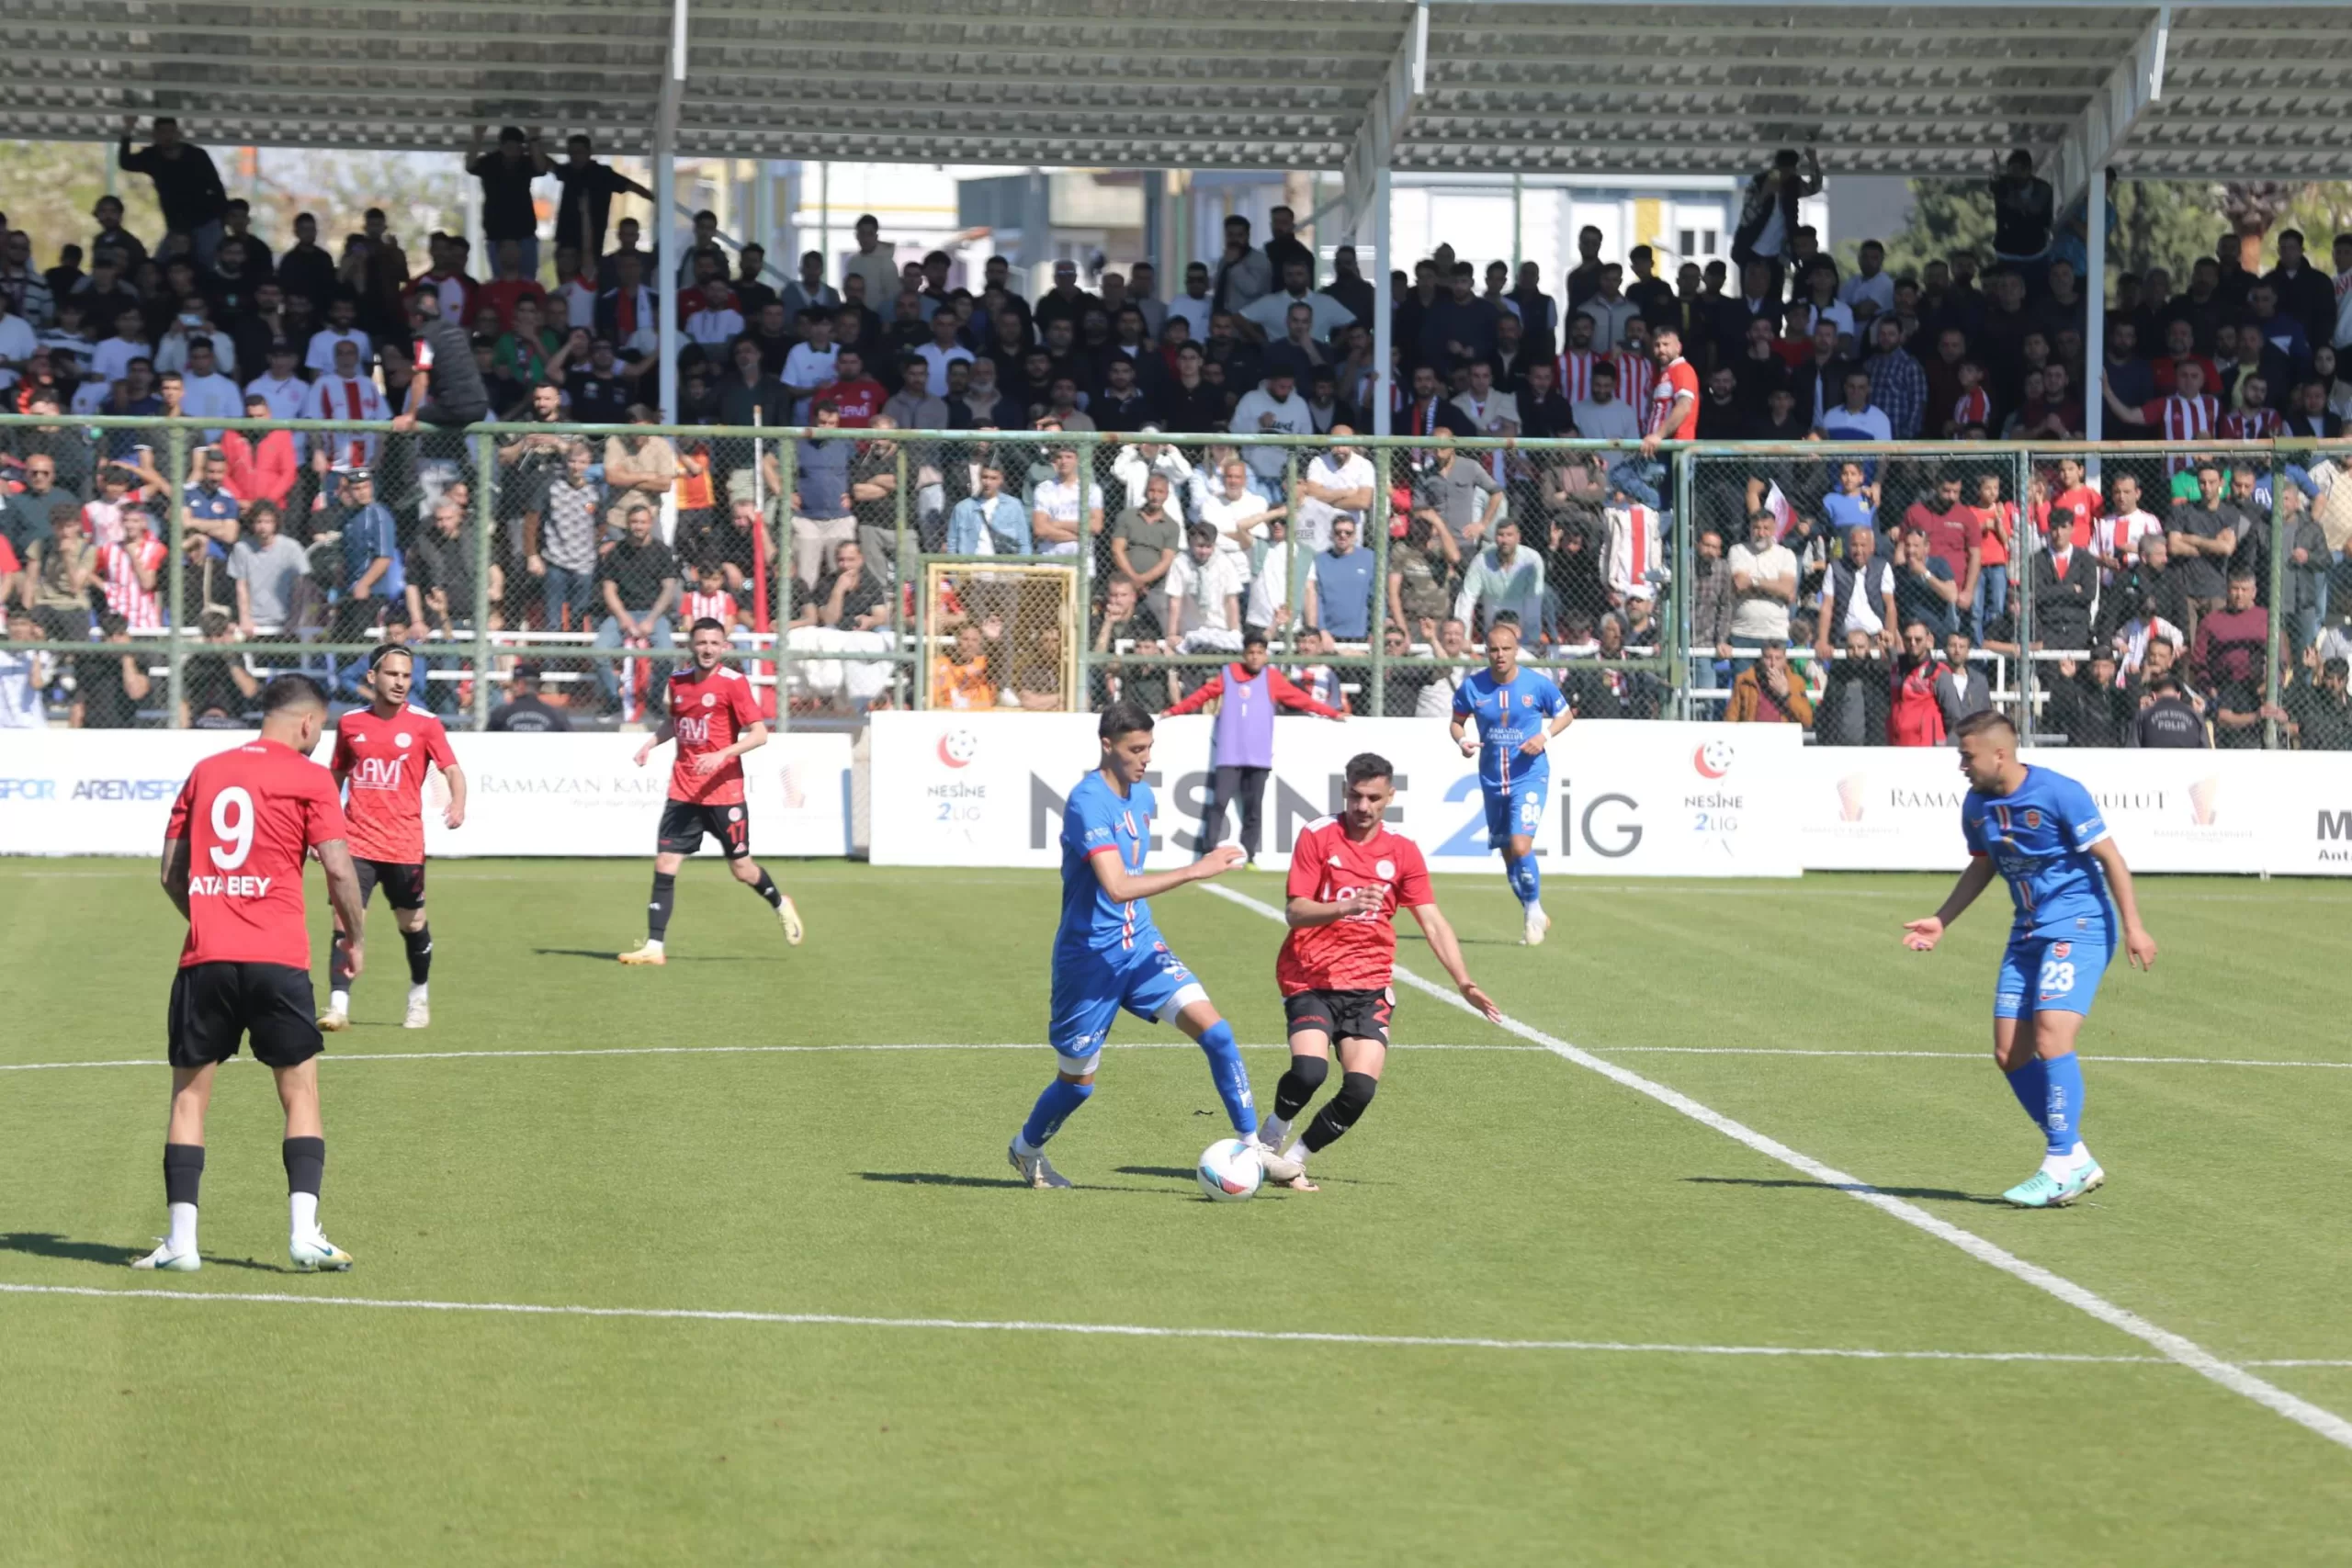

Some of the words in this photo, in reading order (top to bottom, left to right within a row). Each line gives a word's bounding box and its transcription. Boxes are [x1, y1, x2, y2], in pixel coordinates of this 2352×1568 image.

[209, 786, 254, 870] 9
[726, 819, 747, 845] 17
[2317, 809, 2352, 840] M
[2318, 849, 2352, 862] Ant
[188, 875, 270, 897] ATABEY
[2040, 961, 2075, 992] 23
